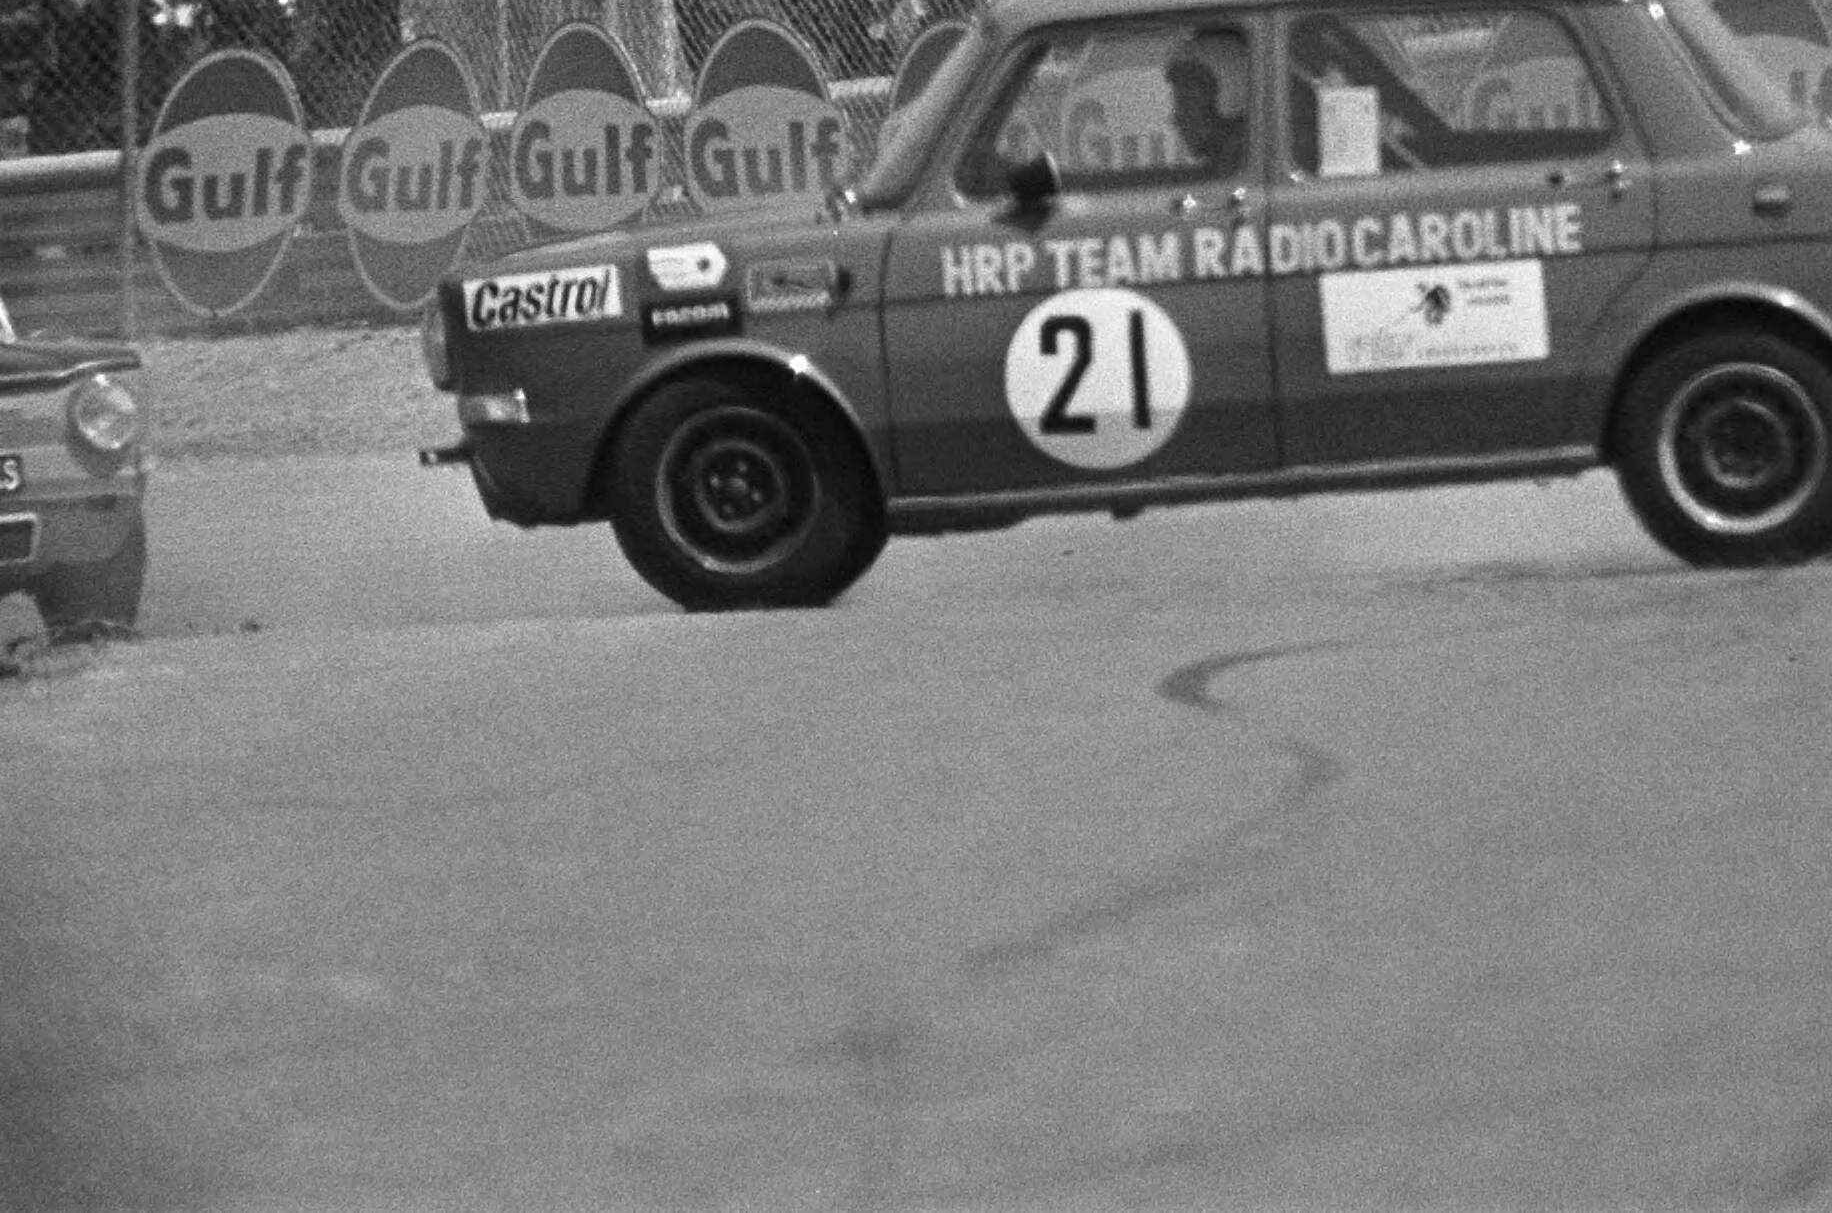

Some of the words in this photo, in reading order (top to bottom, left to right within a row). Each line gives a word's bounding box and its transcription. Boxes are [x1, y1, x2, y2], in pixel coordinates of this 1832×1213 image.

[146, 144, 306, 225] Gulf
[348, 138, 485, 213] Gulf
[515, 119, 652, 200] Gulf
[690, 117, 840, 198] Gulf
[471, 269, 613, 327] Castrol
[941, 241, 1036, 297] HRP
[1046, 231, 1181, 289] TEAM
[1040, 308, 1151, 435] 21
